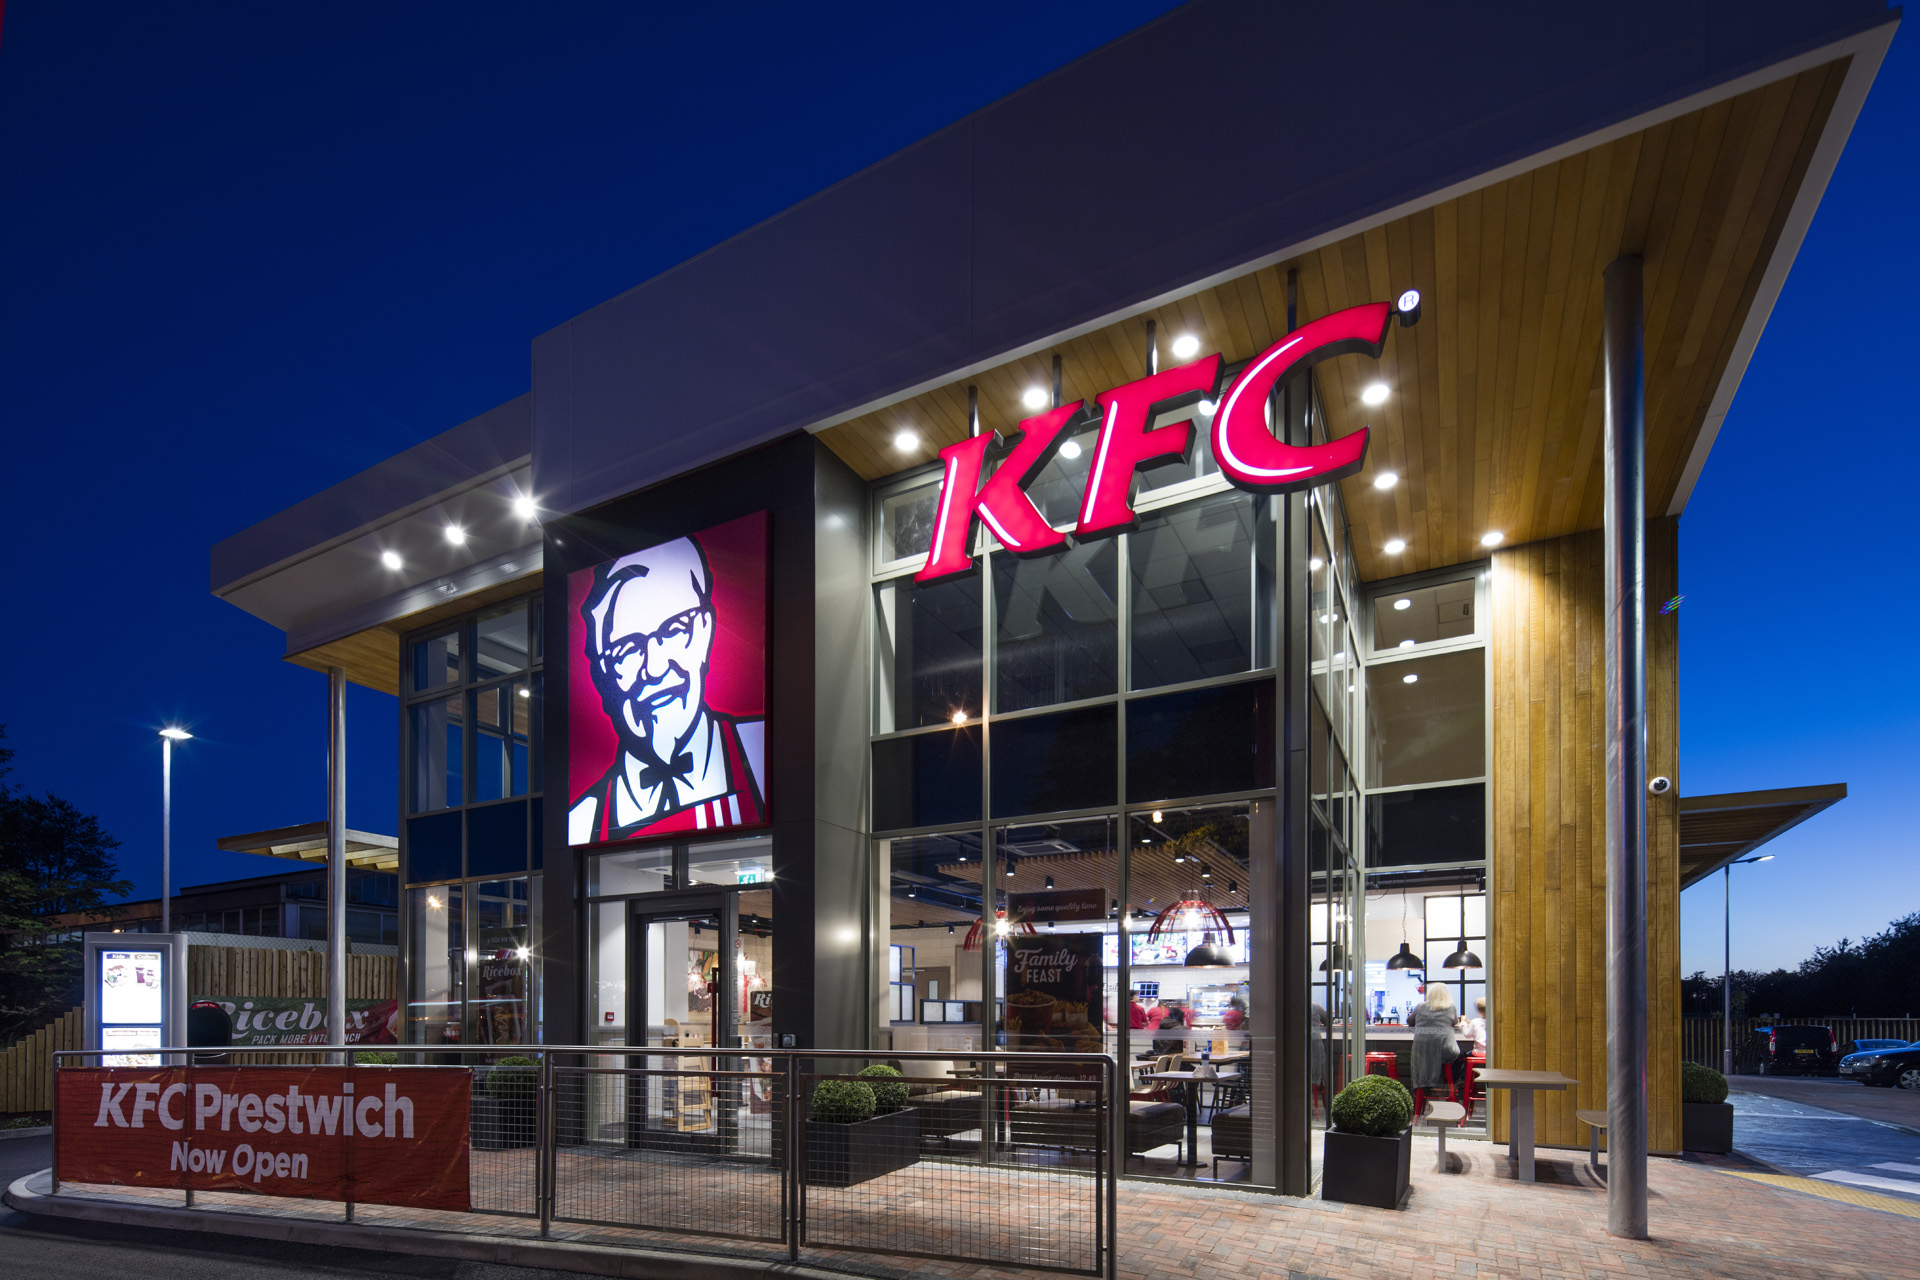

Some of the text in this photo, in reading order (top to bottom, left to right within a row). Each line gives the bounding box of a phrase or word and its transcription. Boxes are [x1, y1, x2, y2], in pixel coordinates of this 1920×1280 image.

[914, 301, 1392, 588] KFC
[1017, 901, 1098, 915] Enjoy some quality time
[1013, 947, 1079, 974] Family
[482, 964, 522, 980] Ricebox
[1026, 968, 1063, 983] FEAST
[753, 993, 772, 1008] Ri
[217, 1001, 370, 1040] icebx
[251, 1034, 278, 1045] PACK
[279, 1033, 307, 1045] MORE
[345, 1032, 361, 1043] NCH
[94, 1082, 415, 1139] KFC Prestwich
[169, 1140, 309, 1184] Now Open
